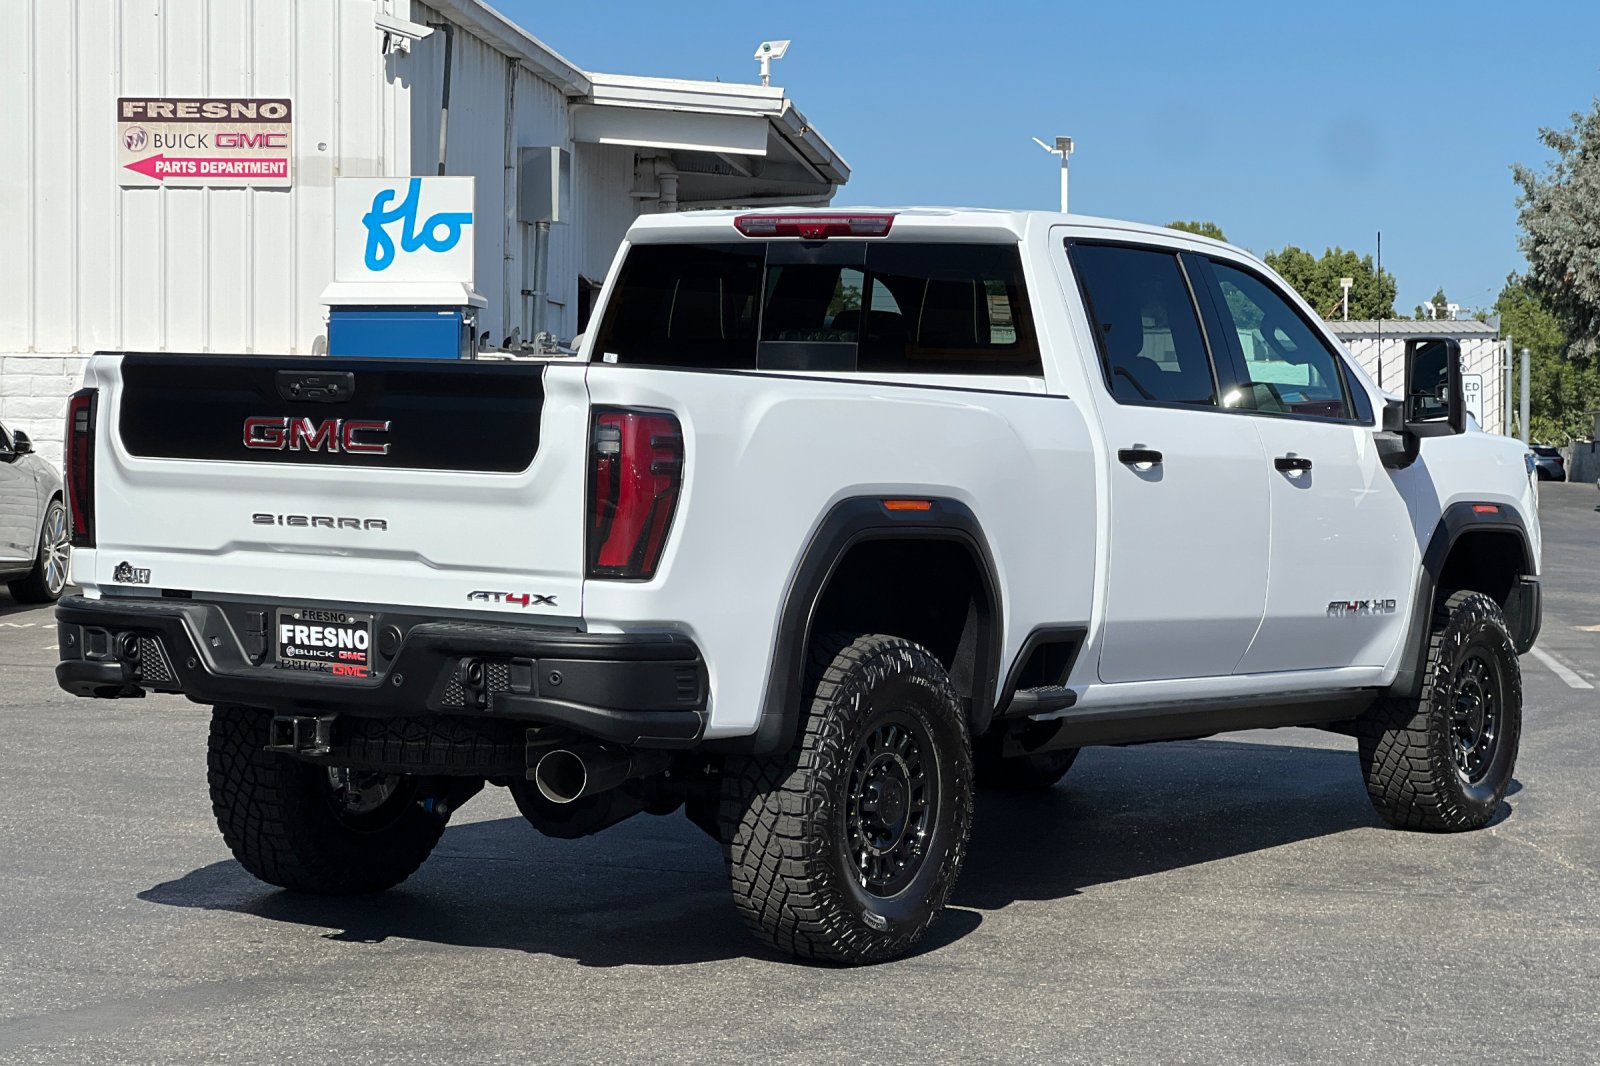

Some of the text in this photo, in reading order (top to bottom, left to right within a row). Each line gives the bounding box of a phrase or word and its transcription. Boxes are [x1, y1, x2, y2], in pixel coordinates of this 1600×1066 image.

[122, 101, 288, 119] FRESNO
[154, 132, 288, 149] BUICK GMC
[155, 160, 286, 175] PARTS DEPARTMENT
[361, 177, 473, 272] flo
[243, 416, 392, 455] GMC
[252, 513, 387, 531] SIERRA
[466, 590, 558, 608] AT4X
[1372, 599, 1396, 610] HD
[302, 609, 346, 622] FRESNO
[281, 623, 369, 650] FRESNO
[295, 648, 367, 661] BUICK GMC
[332, 662, 368, 678] GMC
